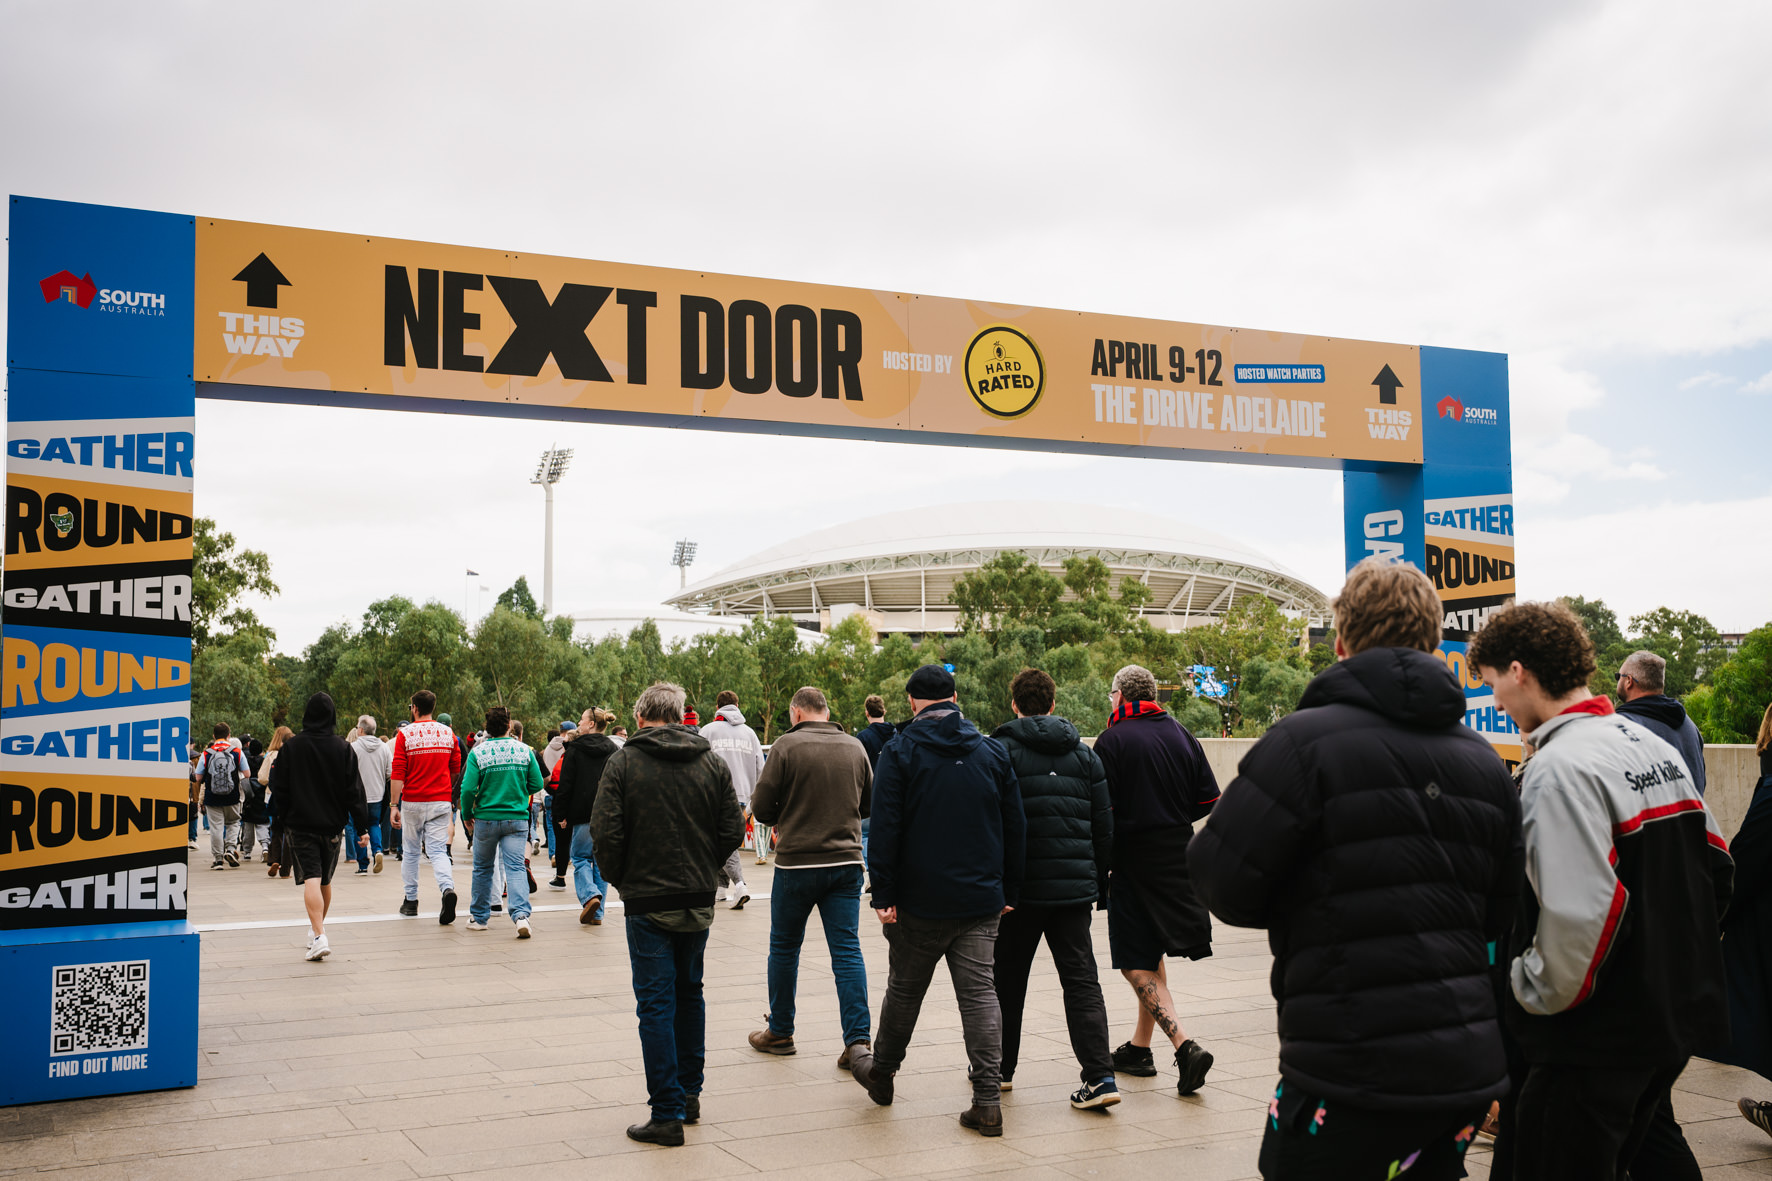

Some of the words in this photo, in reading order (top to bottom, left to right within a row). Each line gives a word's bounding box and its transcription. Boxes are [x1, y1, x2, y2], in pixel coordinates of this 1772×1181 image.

[99, 289, 165, 309] SOUTH
[100, 305, 165, 317] AUSTRALIA
[218, 311, 305, 338] THIS
[384, 264, 658, 386] NEXT
[680, 294, 864, 401] DOOR
[222, 333, 301, 358] WAY
[882, 350, 932, 373] HOSTED
[934, 354, 953, 375] BY
[985, 361, 1022, 375] HARD
[1091, 338, 1163, 382] APRIL
[1168, 345, 1223, 387] 9-12
[1237, 367, 1266, 380] HOSTED
[1266, 367, 1292, 380] WATCH
[1292, 367, 1322, 380] PARTIES
[978, 374, 1035, 396] RATED
[1091, 383, 1138, 425] THE
[1142, 388, 1215, 430] DRIVE
[1220, 394, 1327, 438] ADELAIDE
[1364, 407, 1412, 426] THIS
[1464, 406, 1497, 420] SOUTH
[1367, 423, 1411, 441] WAY
[7, 431, 194, 478] GATHER
[5, 484, 193, 555] ROUND
[1424, 504, 1514, 537] GATHER
[1425, 543, 1515, 590] ROUND
[4, 574, 192, 622] GATHER
[1, 636, 191, 709] ROUND
[1, 716, 190, 763] GATHER
[1624, 764, 1662, 794] Speed
[0, 783, 188, 855] ROUND
[0, 862, 187, 911] GATHER
[48, 1060, 79, 1079] FIND
[82, 1057, 109, 1075] OUT
[111, 1053, 149, 1072] MORE
